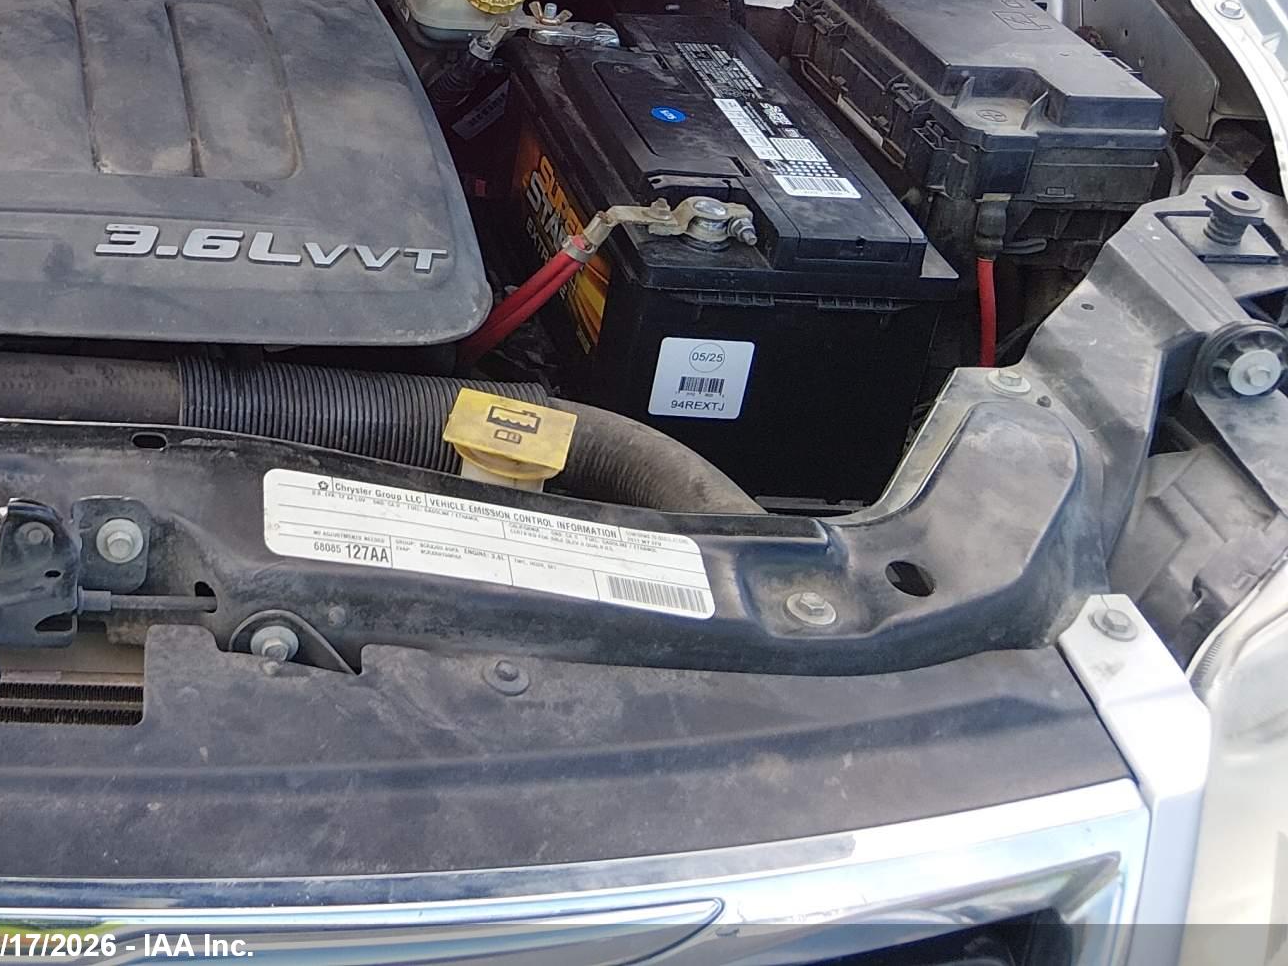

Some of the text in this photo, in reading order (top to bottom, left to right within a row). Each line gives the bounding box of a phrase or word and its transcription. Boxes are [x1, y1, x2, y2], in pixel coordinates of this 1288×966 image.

[691, 352, 724, 363] 05/25
[670, 399, 726, 412] 94REXTJ
[335, 482, 372, 497] Chrysler
[375, 489, 402, 502] Group
[405, 494, 422, 504] LLC
[429, 497, 467, 512] VEHICLE
[469, 504, 511, 520] EMISSION
[514, 513, 555, 528] CONTROL
[556, 521, 617, 539] INFORMATION
[313, 541, 389, 563] 68085 127AA
